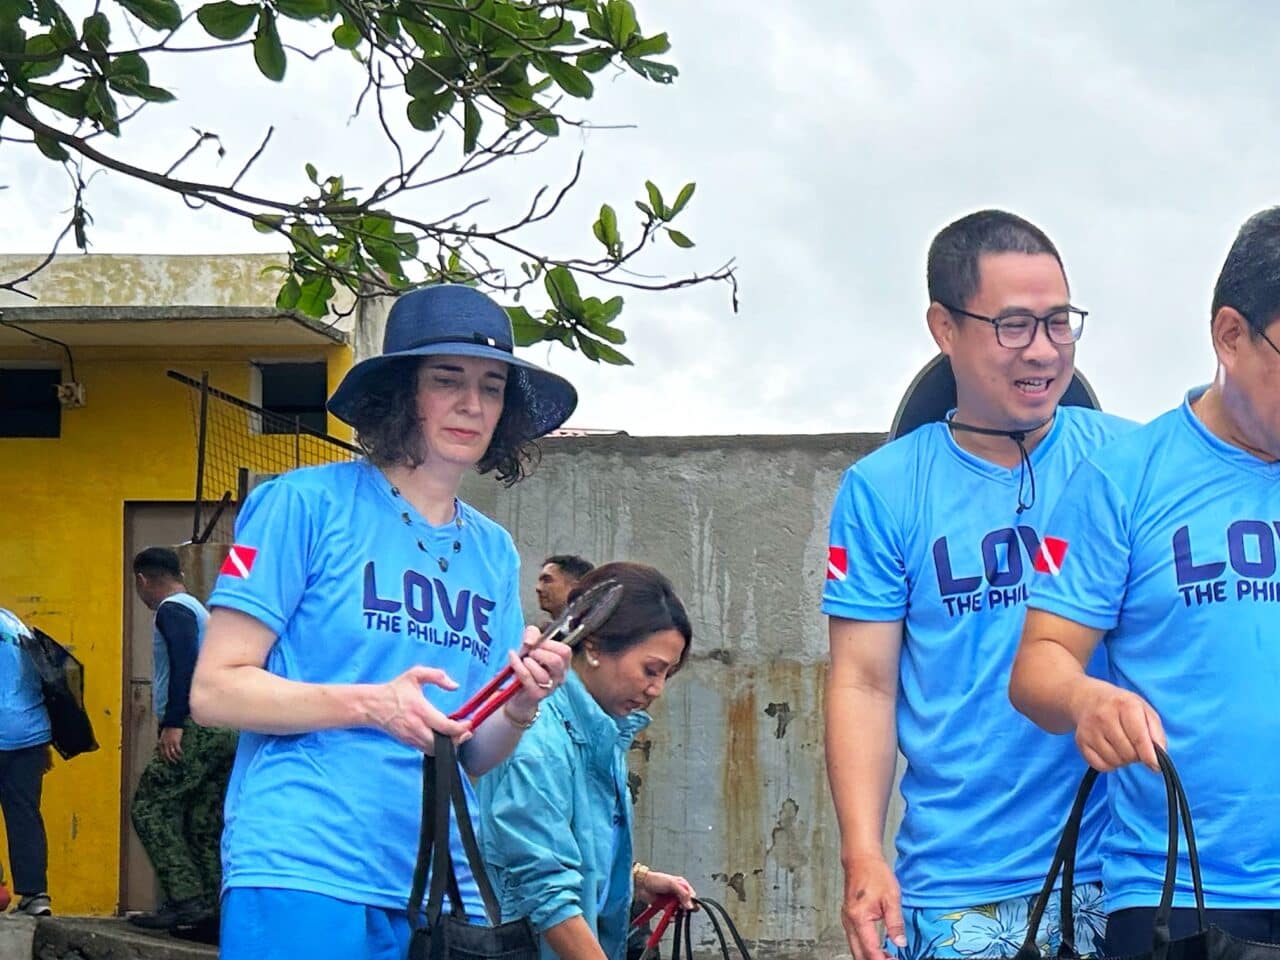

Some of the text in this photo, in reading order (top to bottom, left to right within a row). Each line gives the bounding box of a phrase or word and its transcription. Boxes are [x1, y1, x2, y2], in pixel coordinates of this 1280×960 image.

[363, 561, 497, 647] LOVE
[943, 592, 982, 617] THE
[1178, 580, 1227, 608] THE
[363, 612, 490, 666] THE PHILIPPINE
